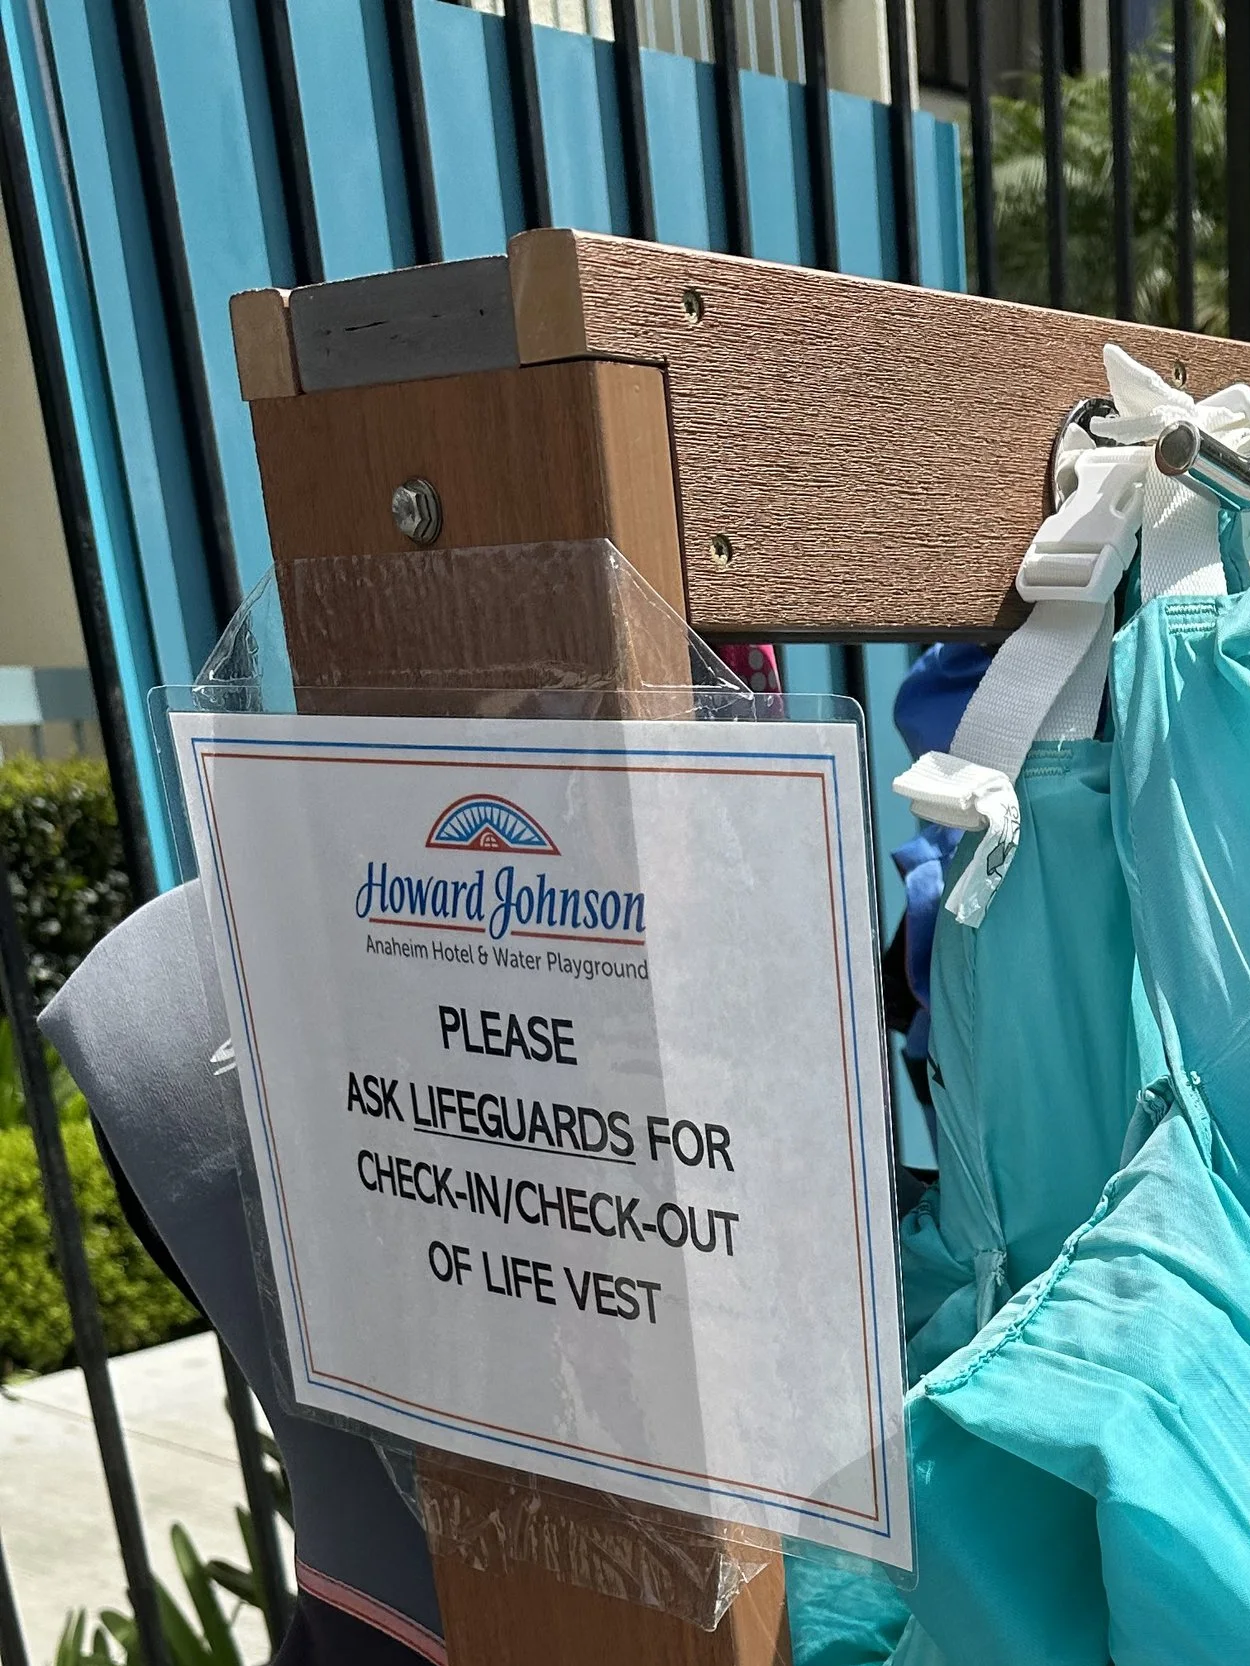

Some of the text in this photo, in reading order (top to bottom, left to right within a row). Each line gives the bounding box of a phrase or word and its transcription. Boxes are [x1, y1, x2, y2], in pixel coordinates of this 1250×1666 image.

[355, 861, 646, 940] Howard Johnson
[366, 934, 649, 980] Anaheim Hotel & Water Playground
[438, 1004, 578, 1066] PLEASE
[347, 1071, 735, 1172] ASK LIFEGUARDS FOR
[357, 1149, 740, 1257] CHECK-IN/CHECK-OUT
[428, 1240, 662, 1325] OF LIFE VEST
